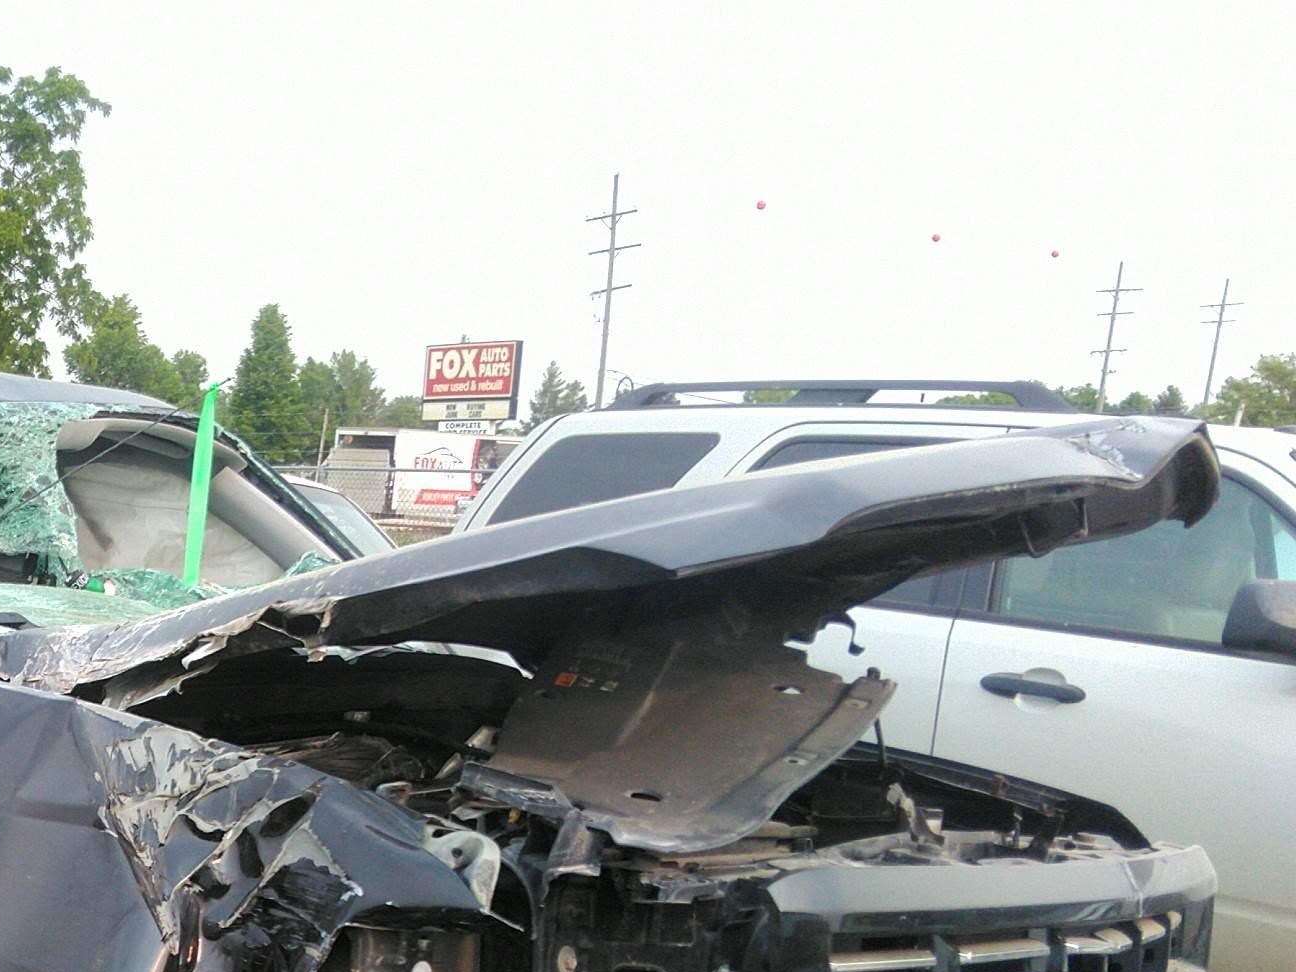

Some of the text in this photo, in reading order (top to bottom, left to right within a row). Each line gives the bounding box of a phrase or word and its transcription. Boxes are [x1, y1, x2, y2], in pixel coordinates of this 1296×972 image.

[480, 347, 509, 362] AUTO
[429, 348, 479, 380] FOX
[478, 362, 510, 378] PARTS
[432, 379, 503, 393] new used & rebuilt
[445, 422, 482, 430] COMPLETE
